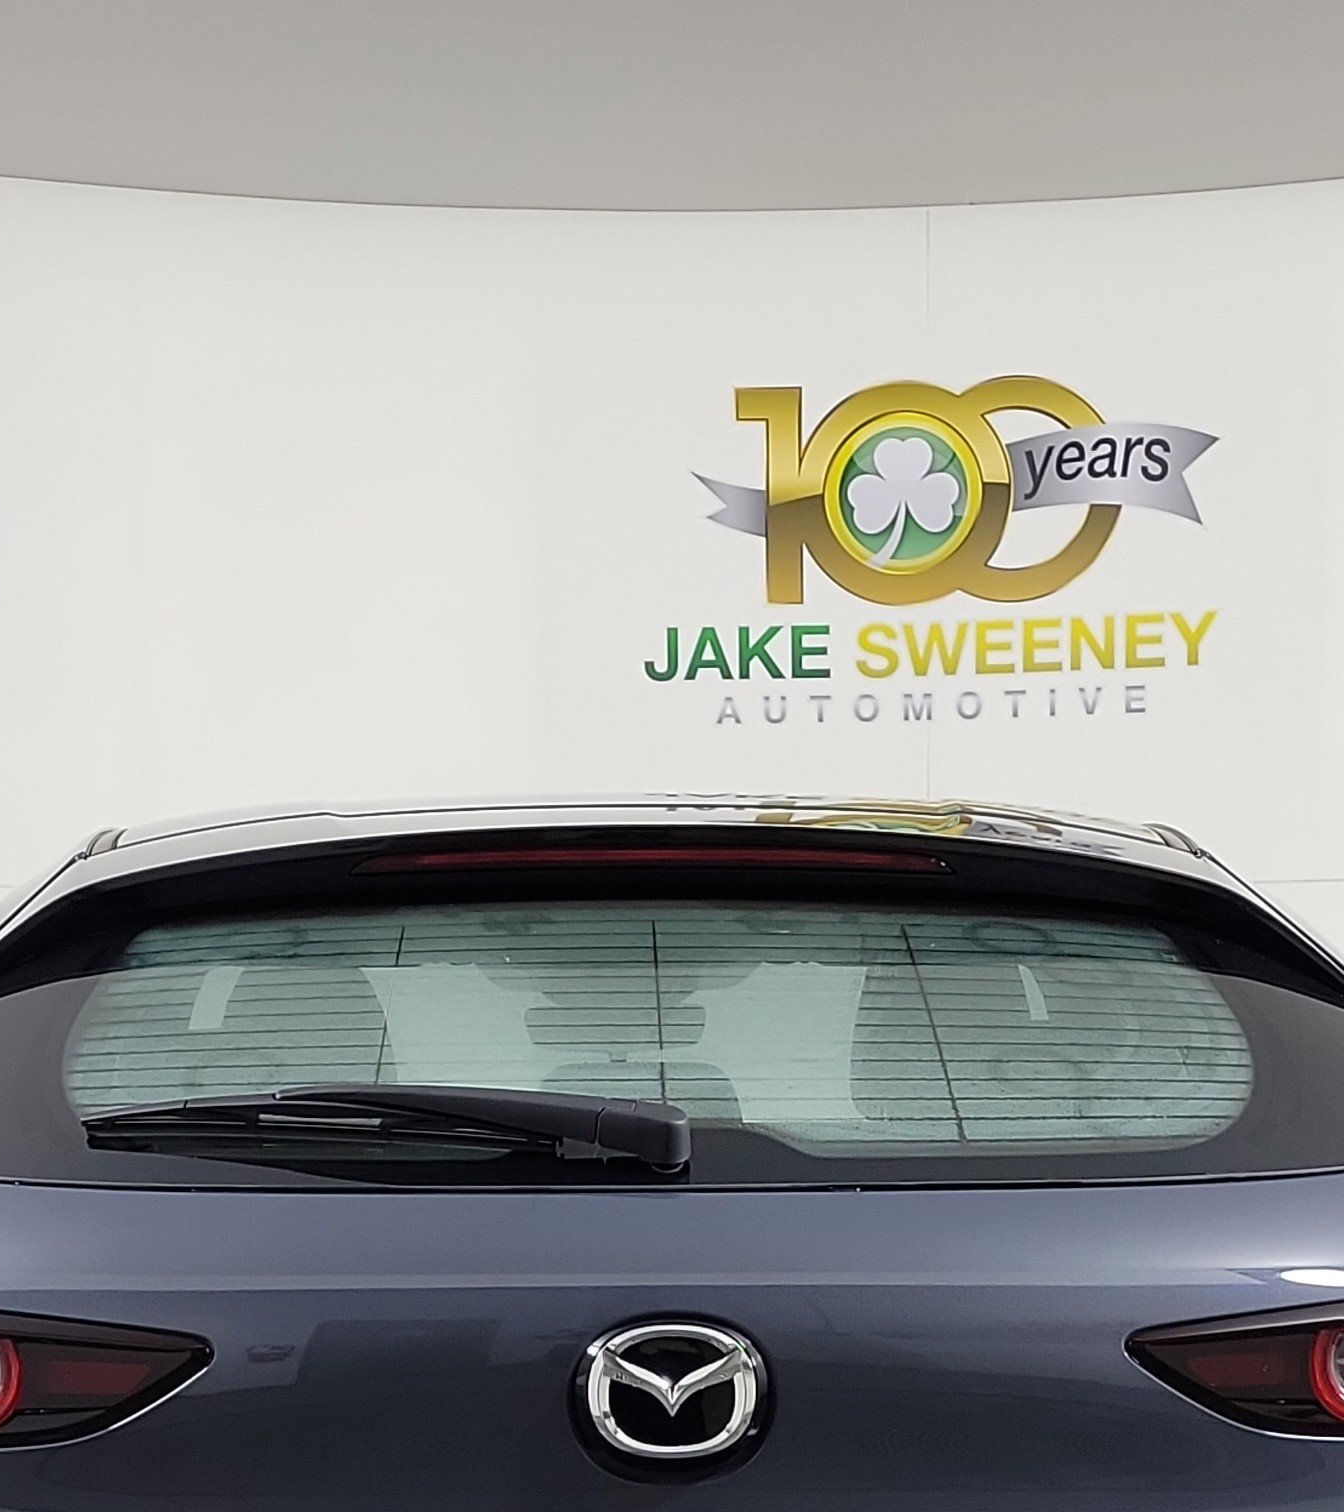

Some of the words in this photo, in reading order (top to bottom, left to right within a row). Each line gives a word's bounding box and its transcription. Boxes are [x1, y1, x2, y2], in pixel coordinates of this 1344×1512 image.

[733, 374, 1123, 606] 100
[1022, 434, 1172, 500] years
[643, 623, 832, 682] JAKE
[854, 610, 1218, 678] SWEENEY
[715, 684, 1147, 725] AUTOMOTIVE
